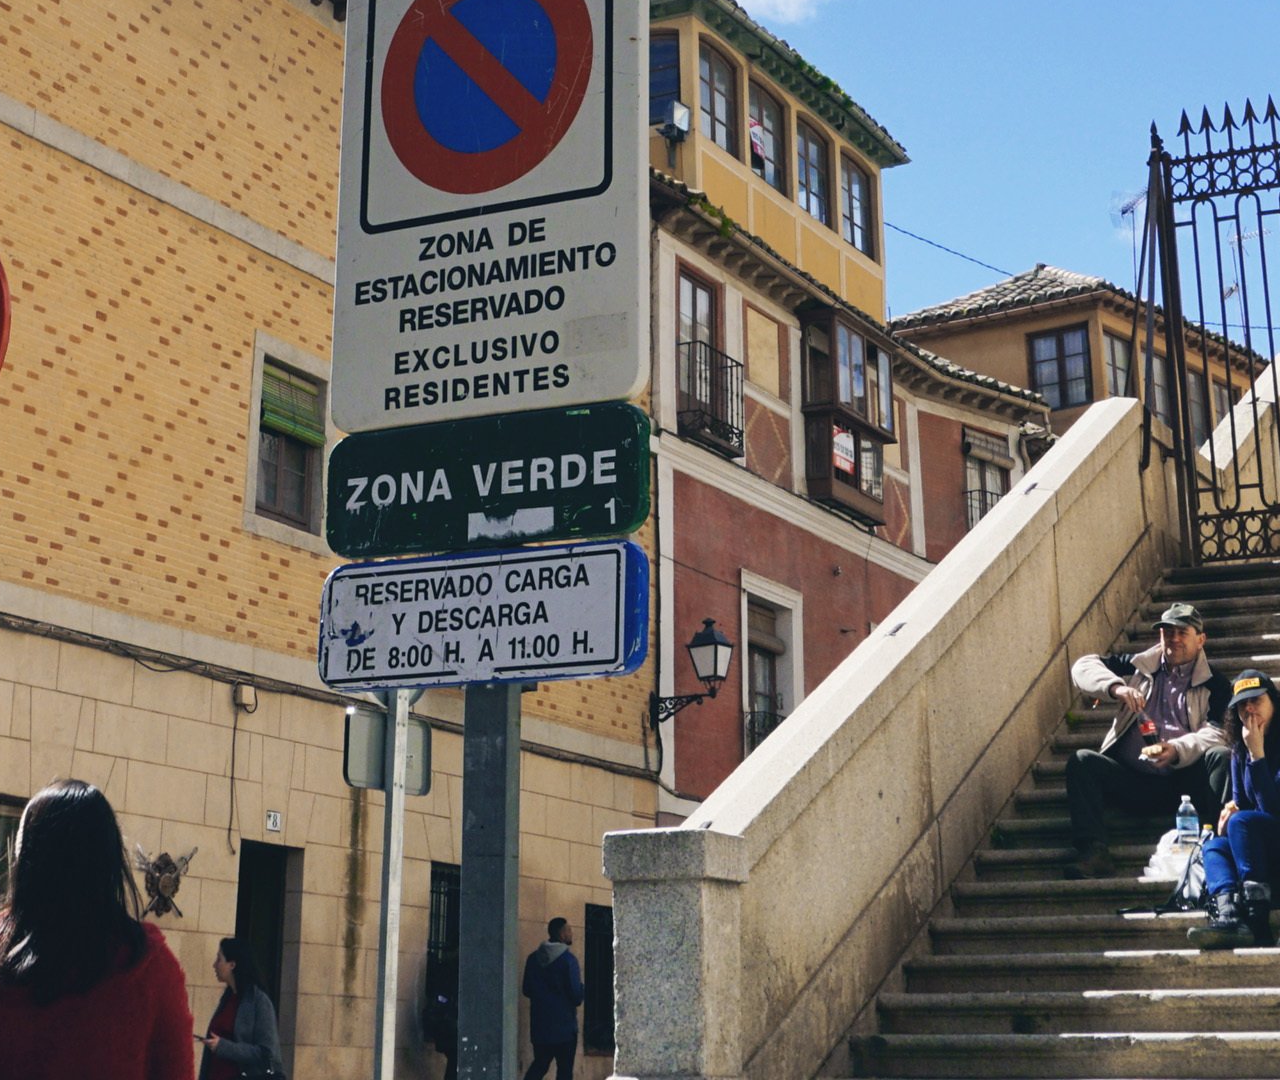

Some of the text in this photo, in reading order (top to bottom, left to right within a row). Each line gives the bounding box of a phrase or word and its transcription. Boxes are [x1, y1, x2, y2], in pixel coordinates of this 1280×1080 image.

[419, 218, 546, 261] ZONA DE
[355, 241, 617, 306] ESTACIONAMIENTO
[399, 285, 565, 333] RESERVADO
[394, 330, 560, 375] EXCLUSIVO
[384, 364, 570, 411] RESIDENTES
[346, 449, 617, 512] ZONA VERDE
[604, 497, 617, 525] 1
[355, 563, 590, 607] RESERVADO CARGA
[391, 600, 549, 636] Y DESCARGA
[347, 647, 376, 673] DE
[388, 645, 433, 669] 8:00
[445, 641, 465, 664] H.
[478, 639, 495, 661] A
[572, 630, 594, 655] H.
